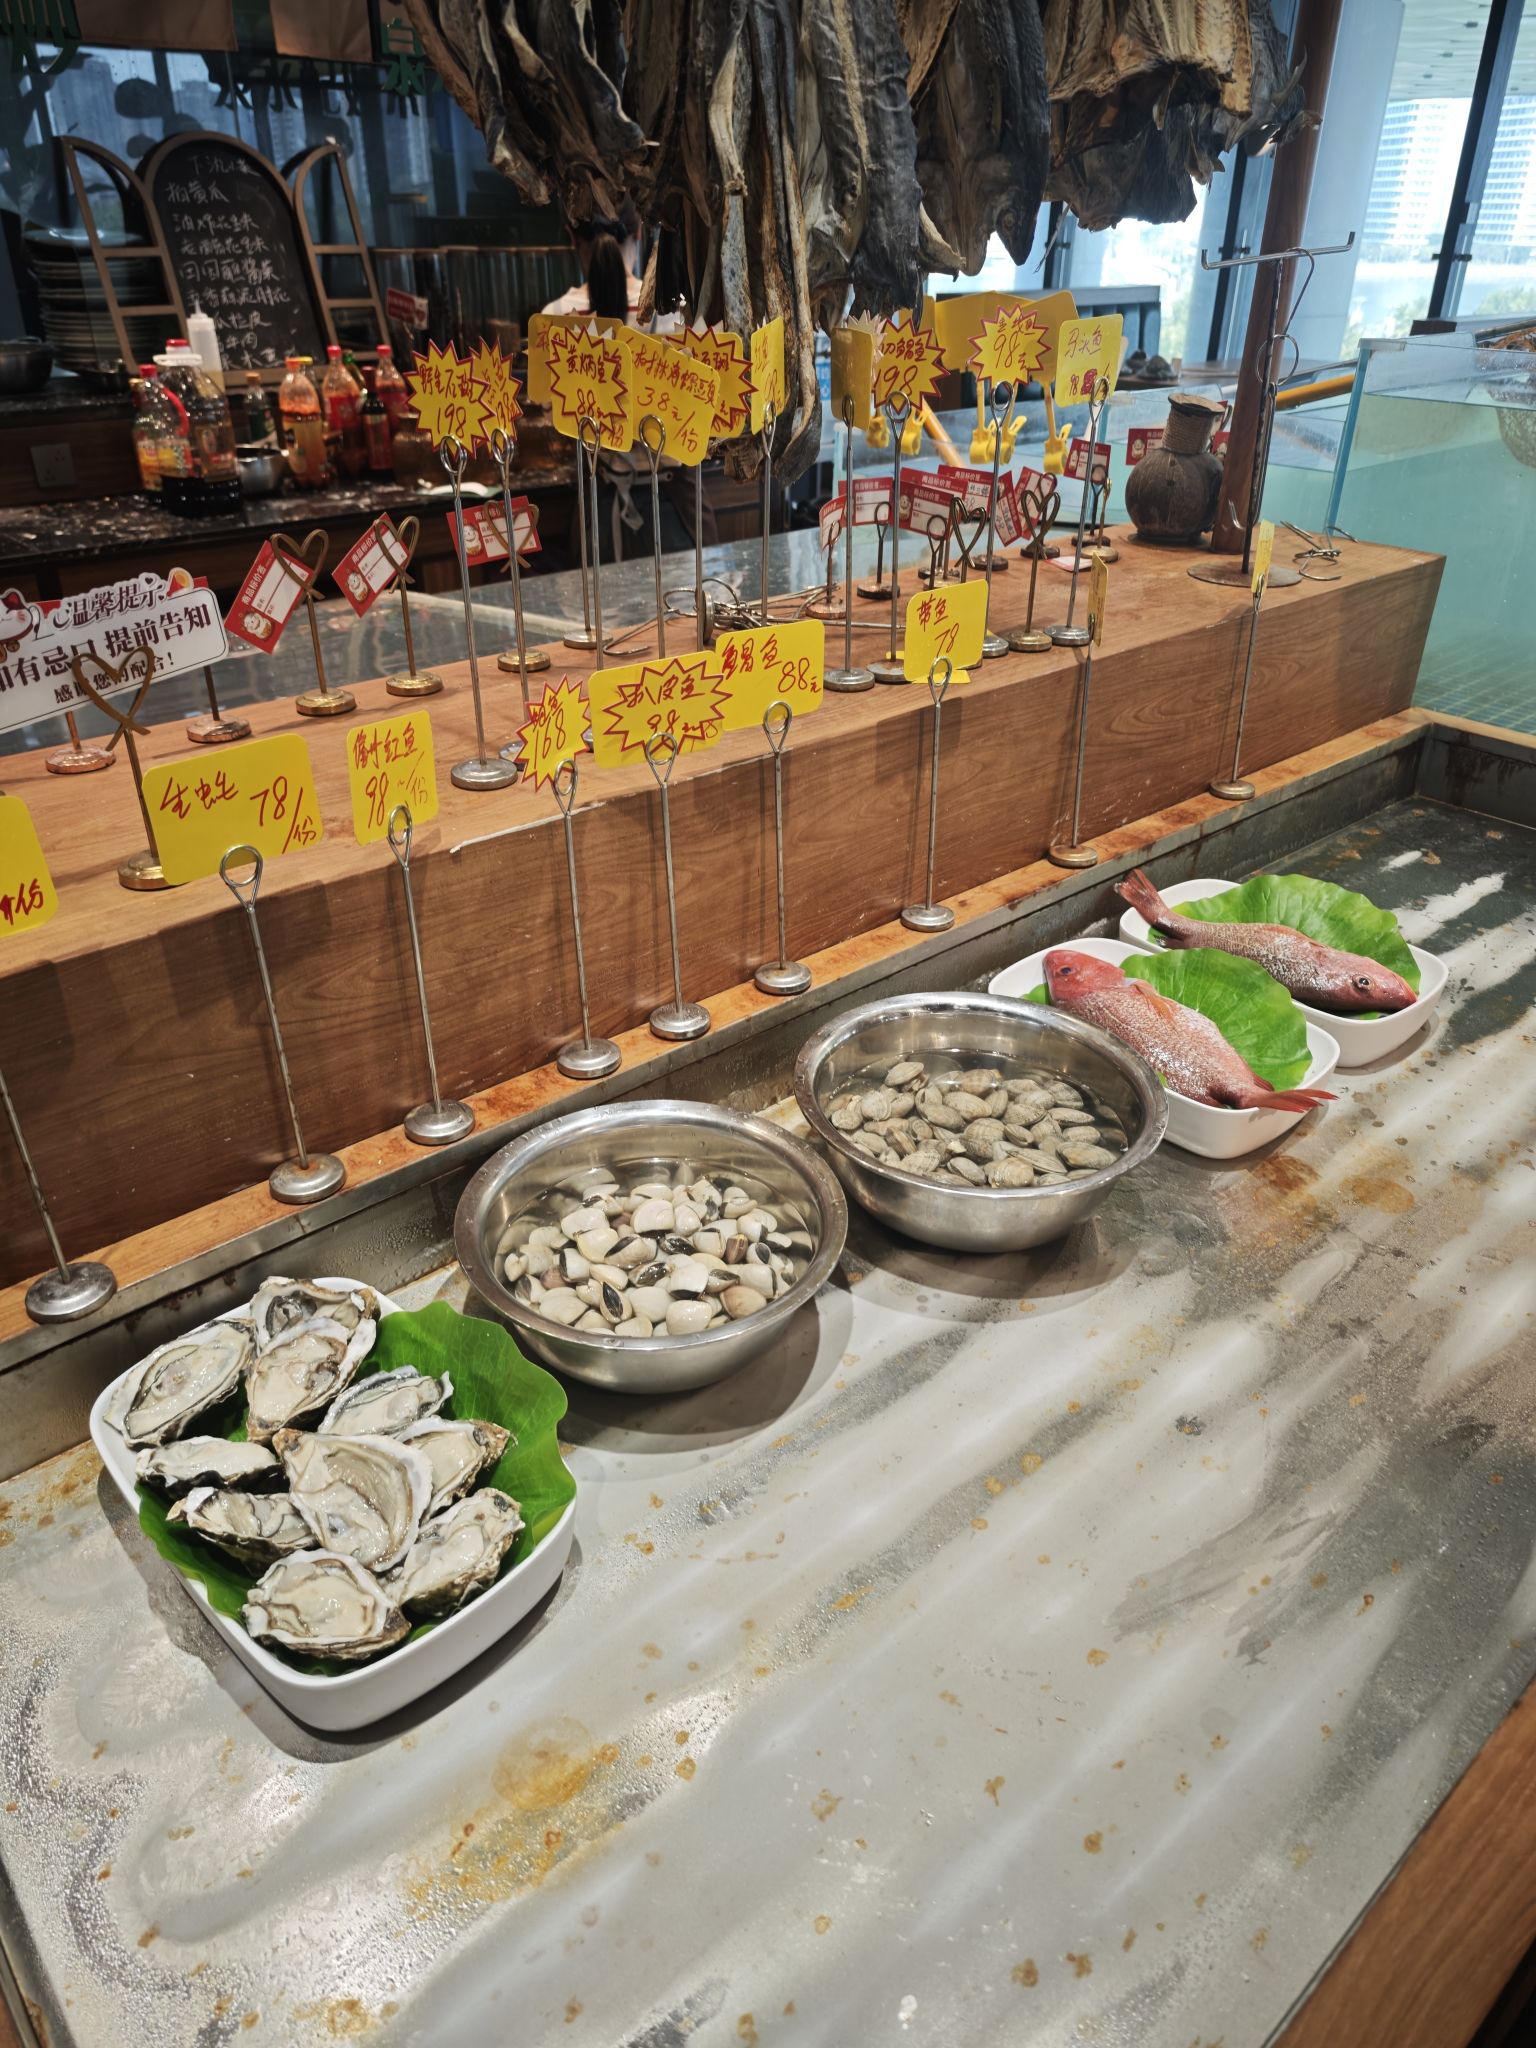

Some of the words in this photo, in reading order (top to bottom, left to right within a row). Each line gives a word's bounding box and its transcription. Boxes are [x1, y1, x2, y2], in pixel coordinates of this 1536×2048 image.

[166, 181, 230, 203] 拍黄瓜
[873, 365, 918, 398] 198
[437, 403, 467, 438] 198
[54, 584, 164, 628] 温馨提示
[917, 594, 949, 632] 带鱼
[104, 603, 212, 658] 提前告知
[934, 623, 960, 657] 78
[535, 711, 571, 777] 168
[160, 770, 240, 819] 生蚝
